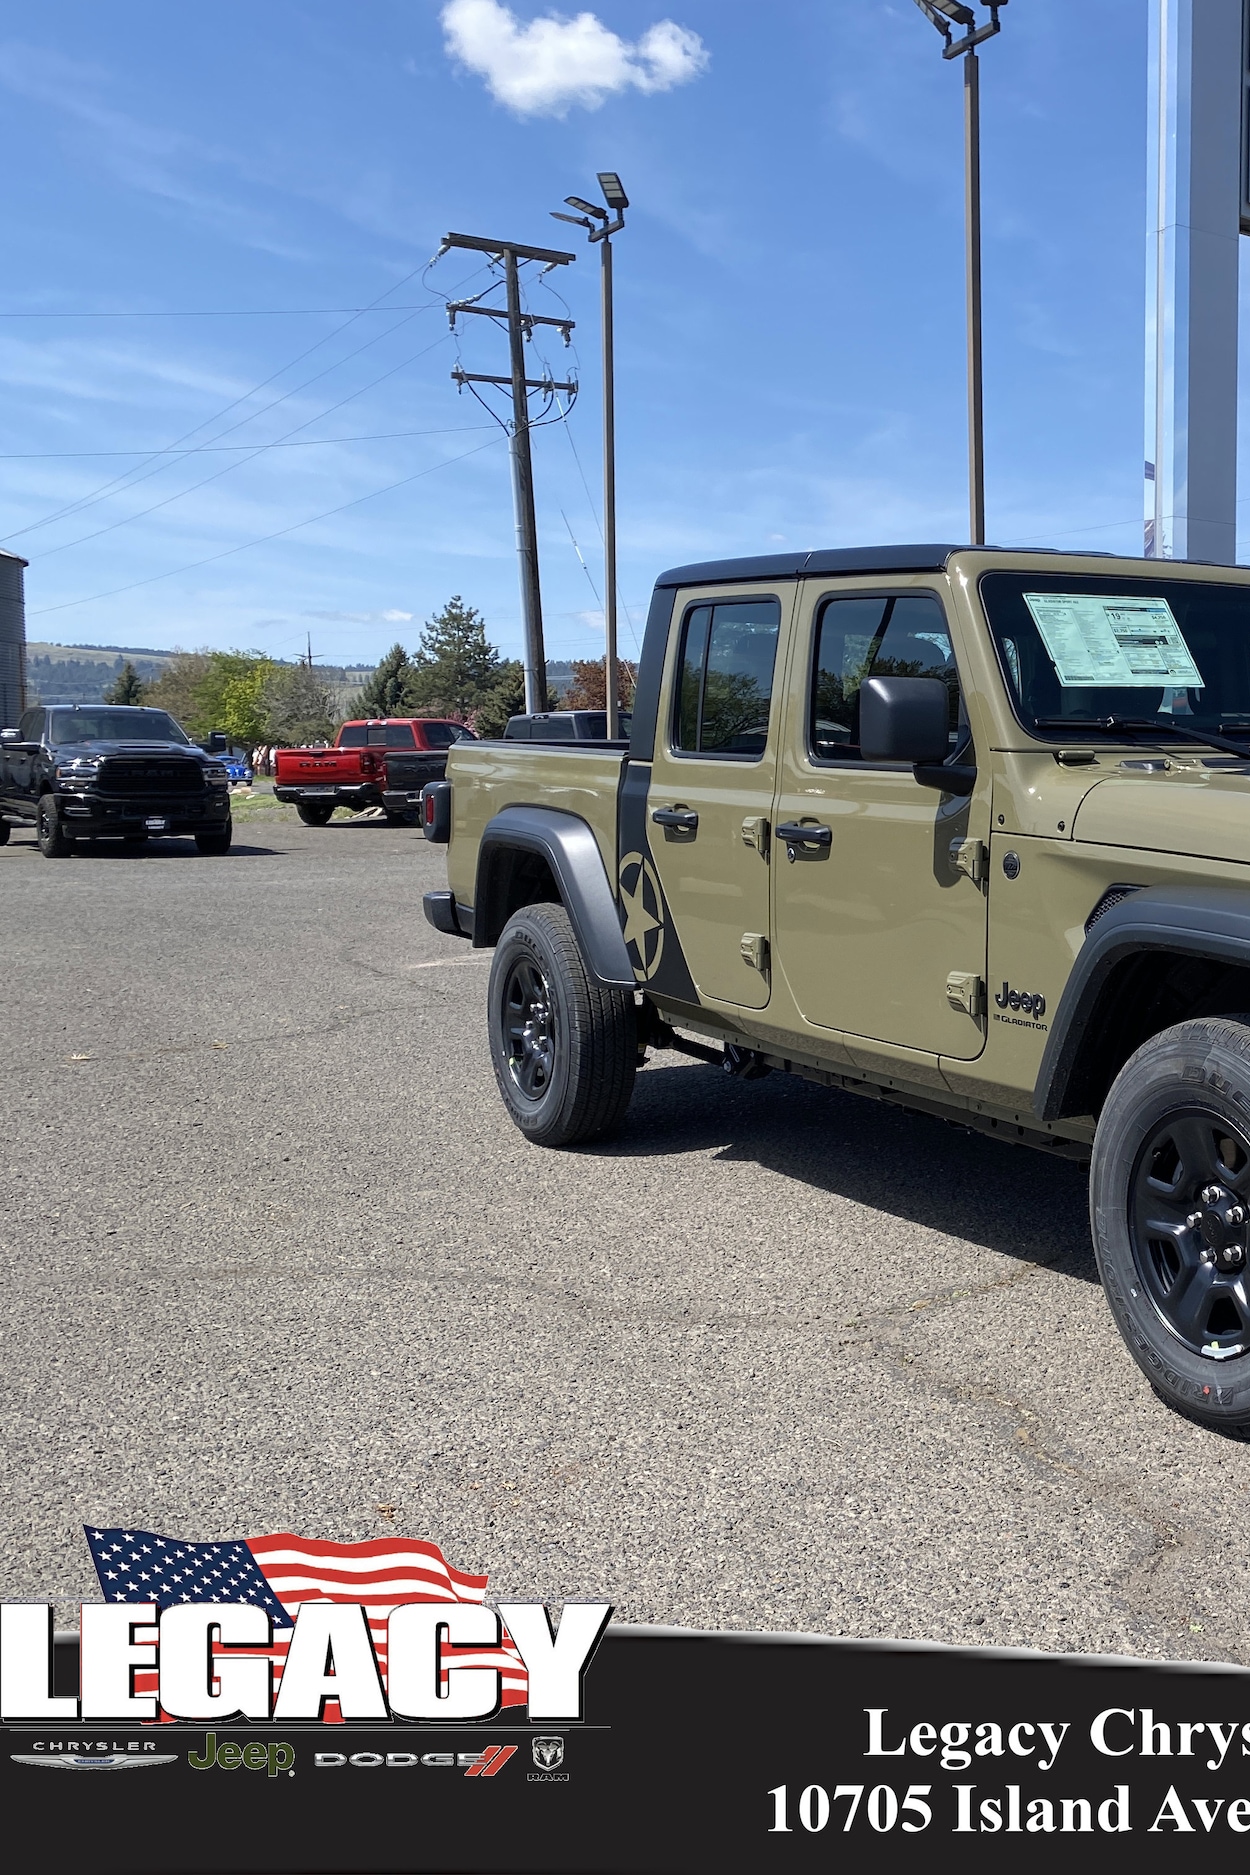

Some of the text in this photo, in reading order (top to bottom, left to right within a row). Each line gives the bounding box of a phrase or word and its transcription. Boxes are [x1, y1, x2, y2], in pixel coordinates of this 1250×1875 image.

[1111, 612, 1121, 620] 19
[299, 760, 337, 768] RAM
[994, 981, 1046, 1021] Jeep
[1001, 1015, 1048, 1032] GLADIATOR
